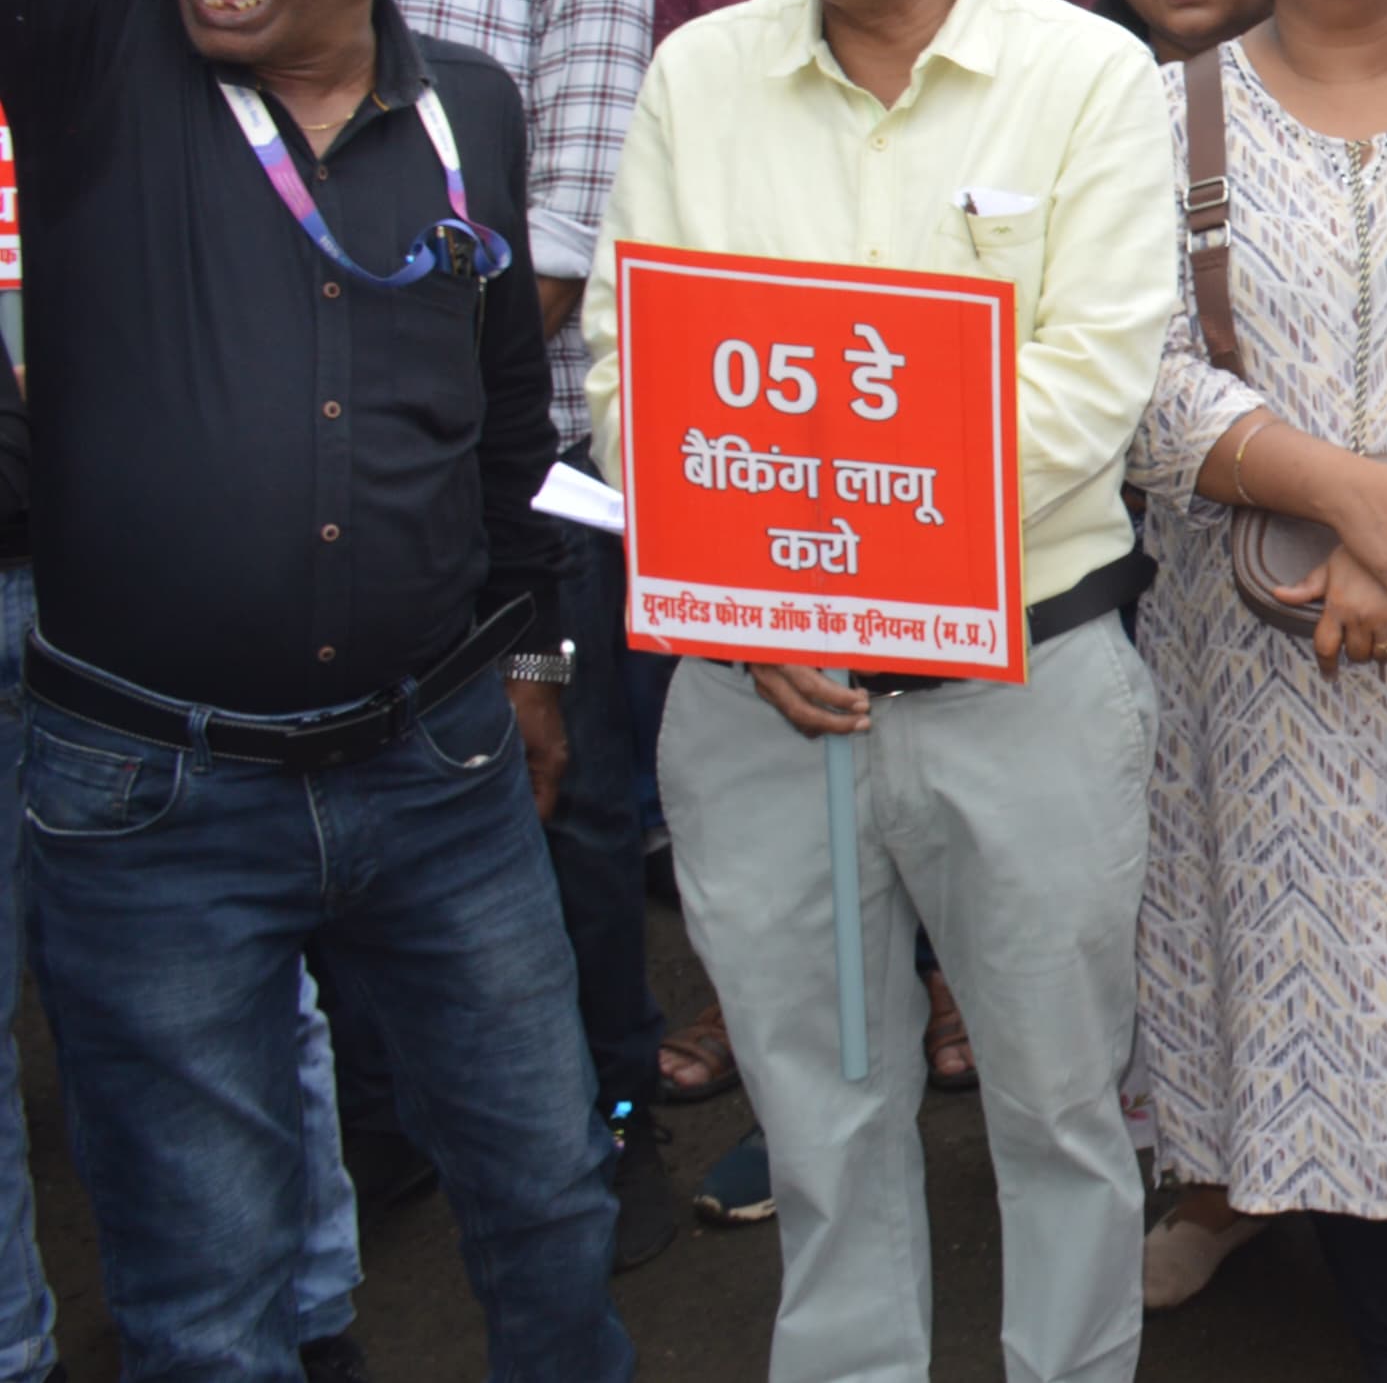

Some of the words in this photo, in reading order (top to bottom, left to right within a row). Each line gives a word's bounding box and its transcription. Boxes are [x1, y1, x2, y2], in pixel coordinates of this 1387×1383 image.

[713, 338, 818, 415] 05
[844, 323, 905, 421] डे
[681, 428, 821, 499] बैंकिंग
[832, 459, 944, 526] लागू
[767, 518, 860, 575] करो
[715, 596, 763, 629] फोरम
[813, 602, 848, 636] बैंक
